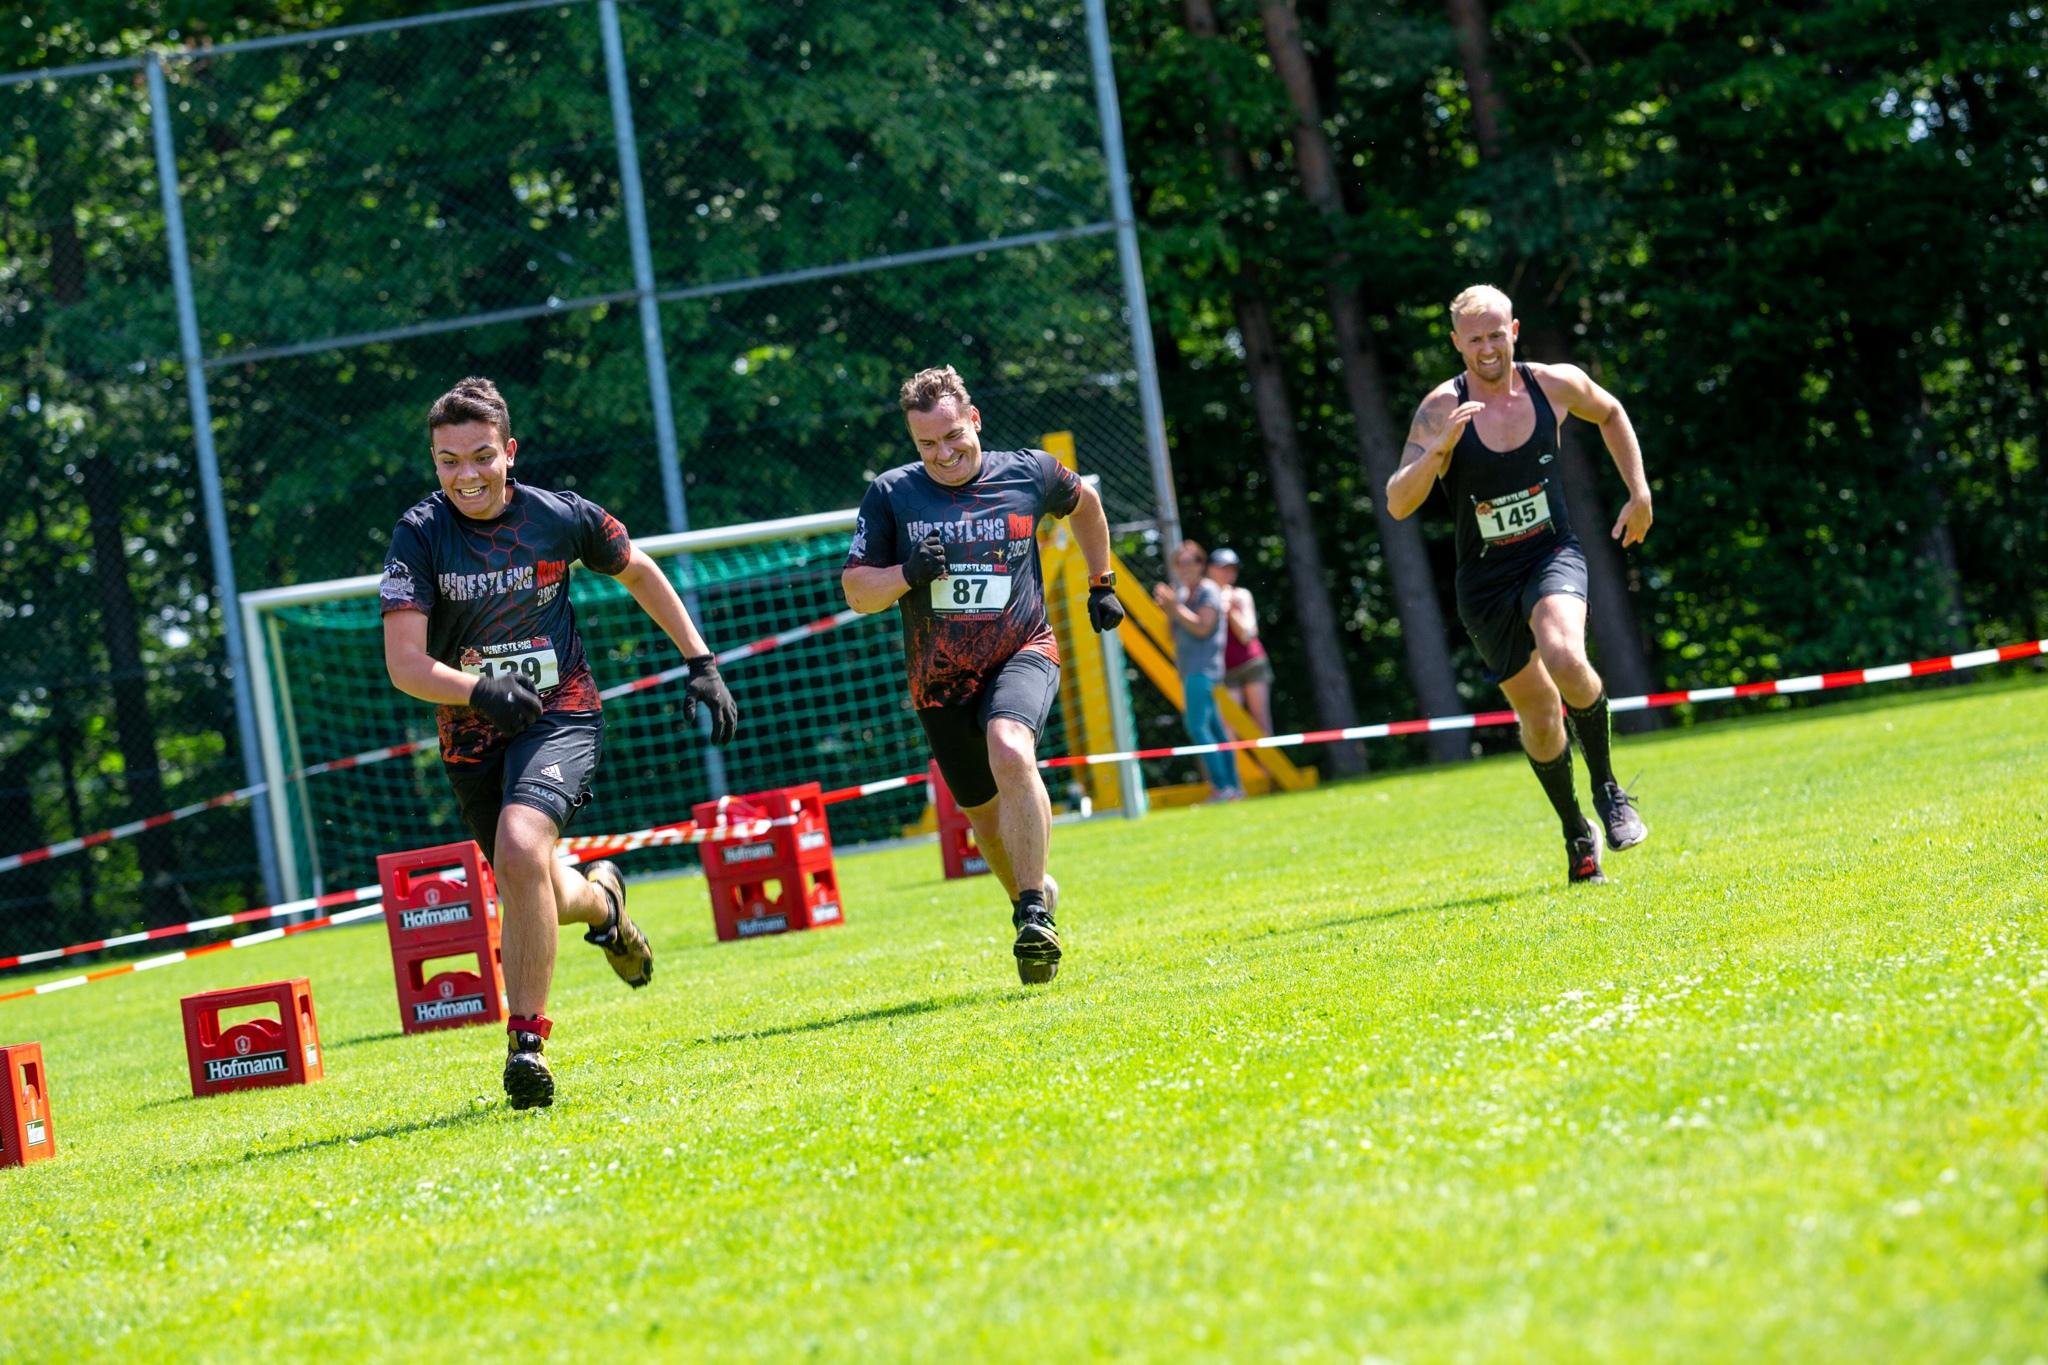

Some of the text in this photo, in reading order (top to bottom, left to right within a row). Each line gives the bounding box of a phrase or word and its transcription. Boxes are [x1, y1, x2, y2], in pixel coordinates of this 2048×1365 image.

[1491, 502, 1537, 532] 145
[953, 578, 988, 605] 87
[528, 785, 555, 801] JAKO
[403, 905, 469, 929] Hofmann
[416, 999, 483, 1021] Hofmann
[209, 1055, 284, 1079] Hofmann
